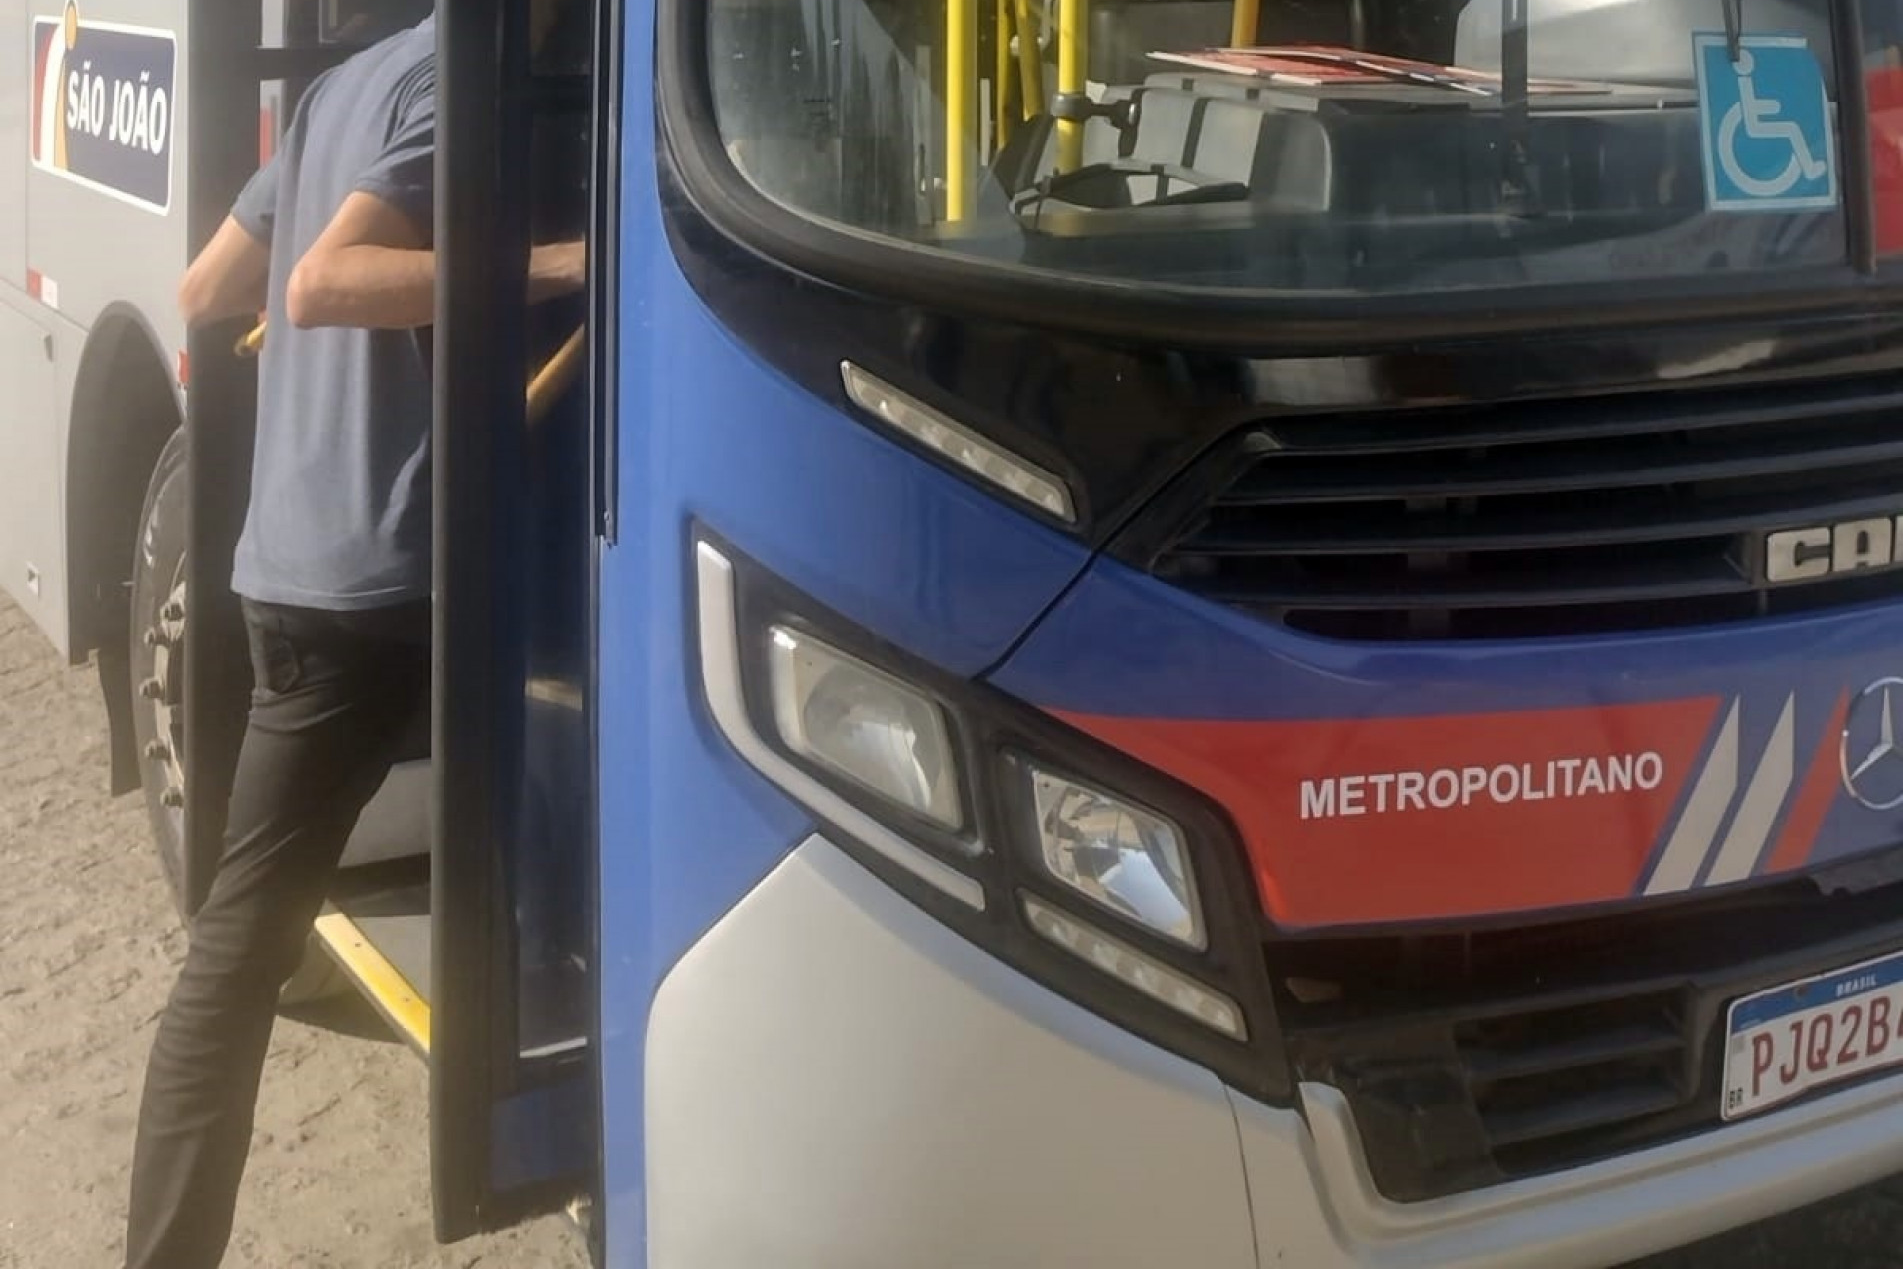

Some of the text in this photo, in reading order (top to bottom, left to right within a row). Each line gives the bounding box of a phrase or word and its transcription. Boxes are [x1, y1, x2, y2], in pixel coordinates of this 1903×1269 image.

[66, 60, 167, 154] SÃO JOÃO
[1300, 751, 1663, 820] METROPOLITANO
